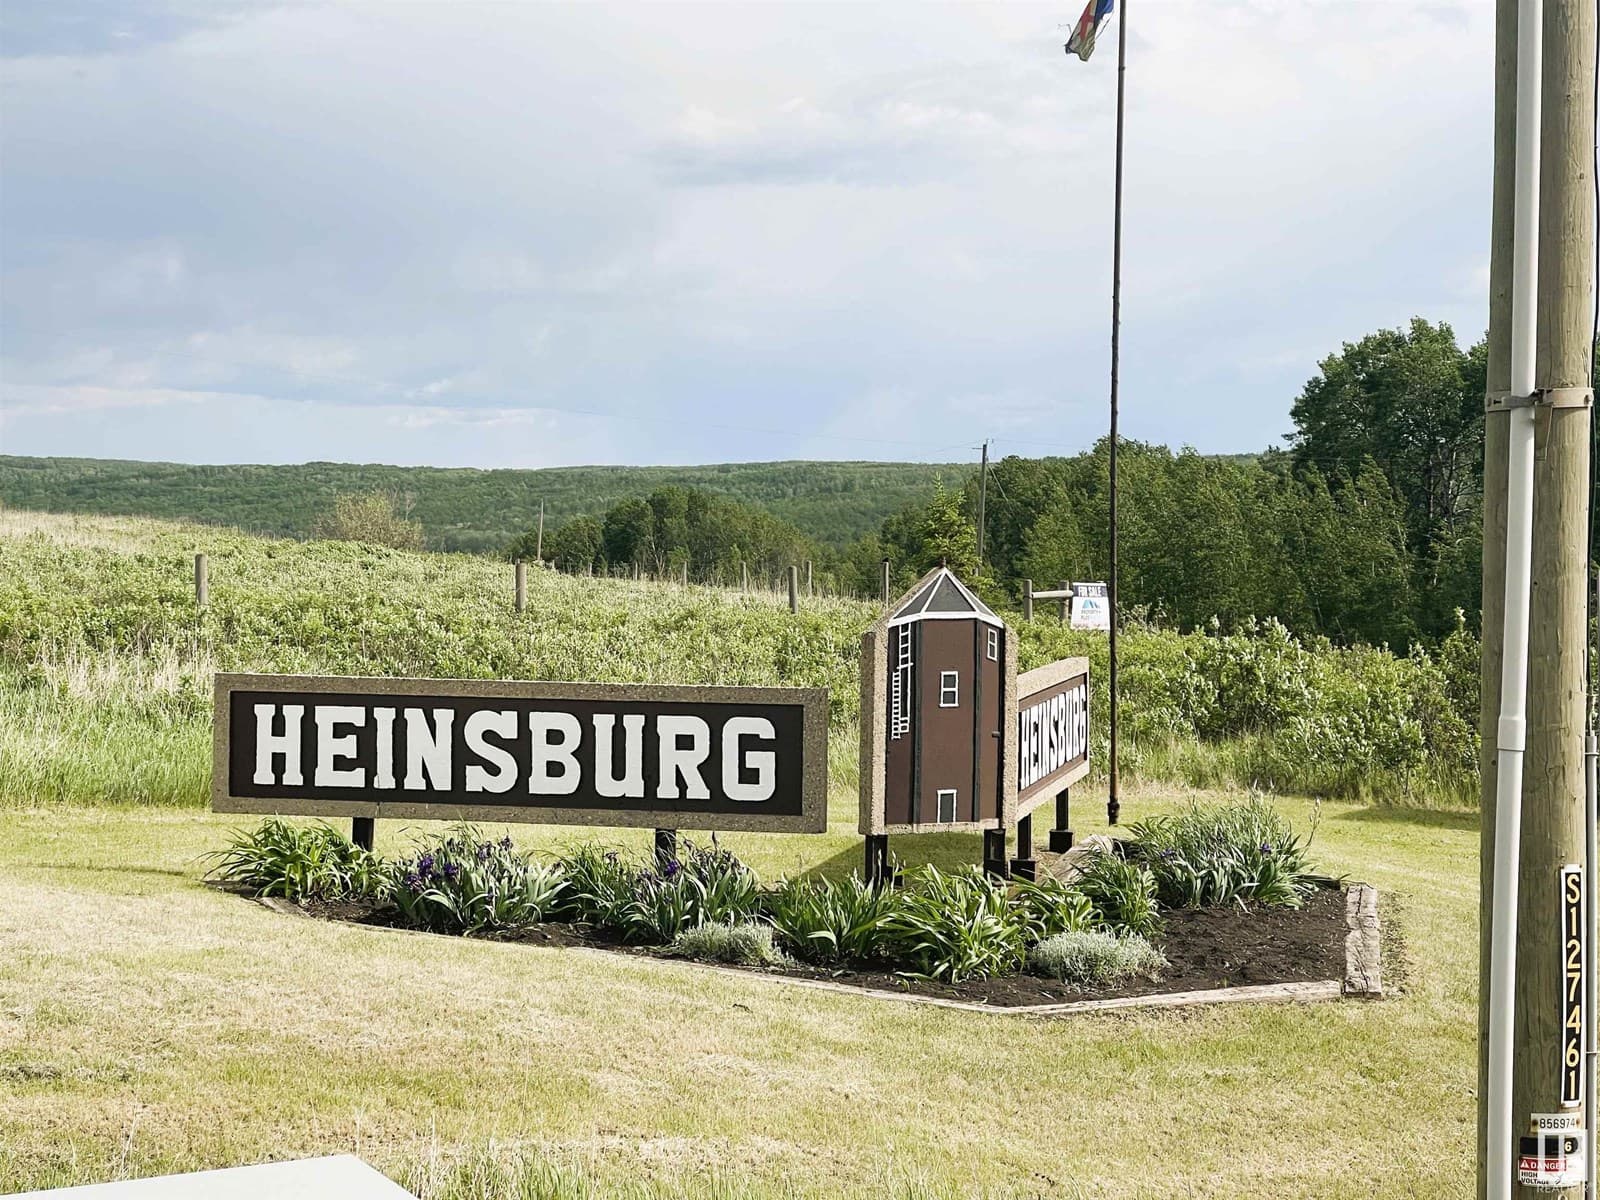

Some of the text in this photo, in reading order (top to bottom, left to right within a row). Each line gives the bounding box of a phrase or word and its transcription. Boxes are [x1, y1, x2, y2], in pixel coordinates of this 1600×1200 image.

[253, 703, 776, 801] HEINSBURG
[1020, 684, 1087, 791] HEINSBURG
[1565, 873, 1581, 1100] S127461
[1539, 1118, 1575, 1129] 856974
